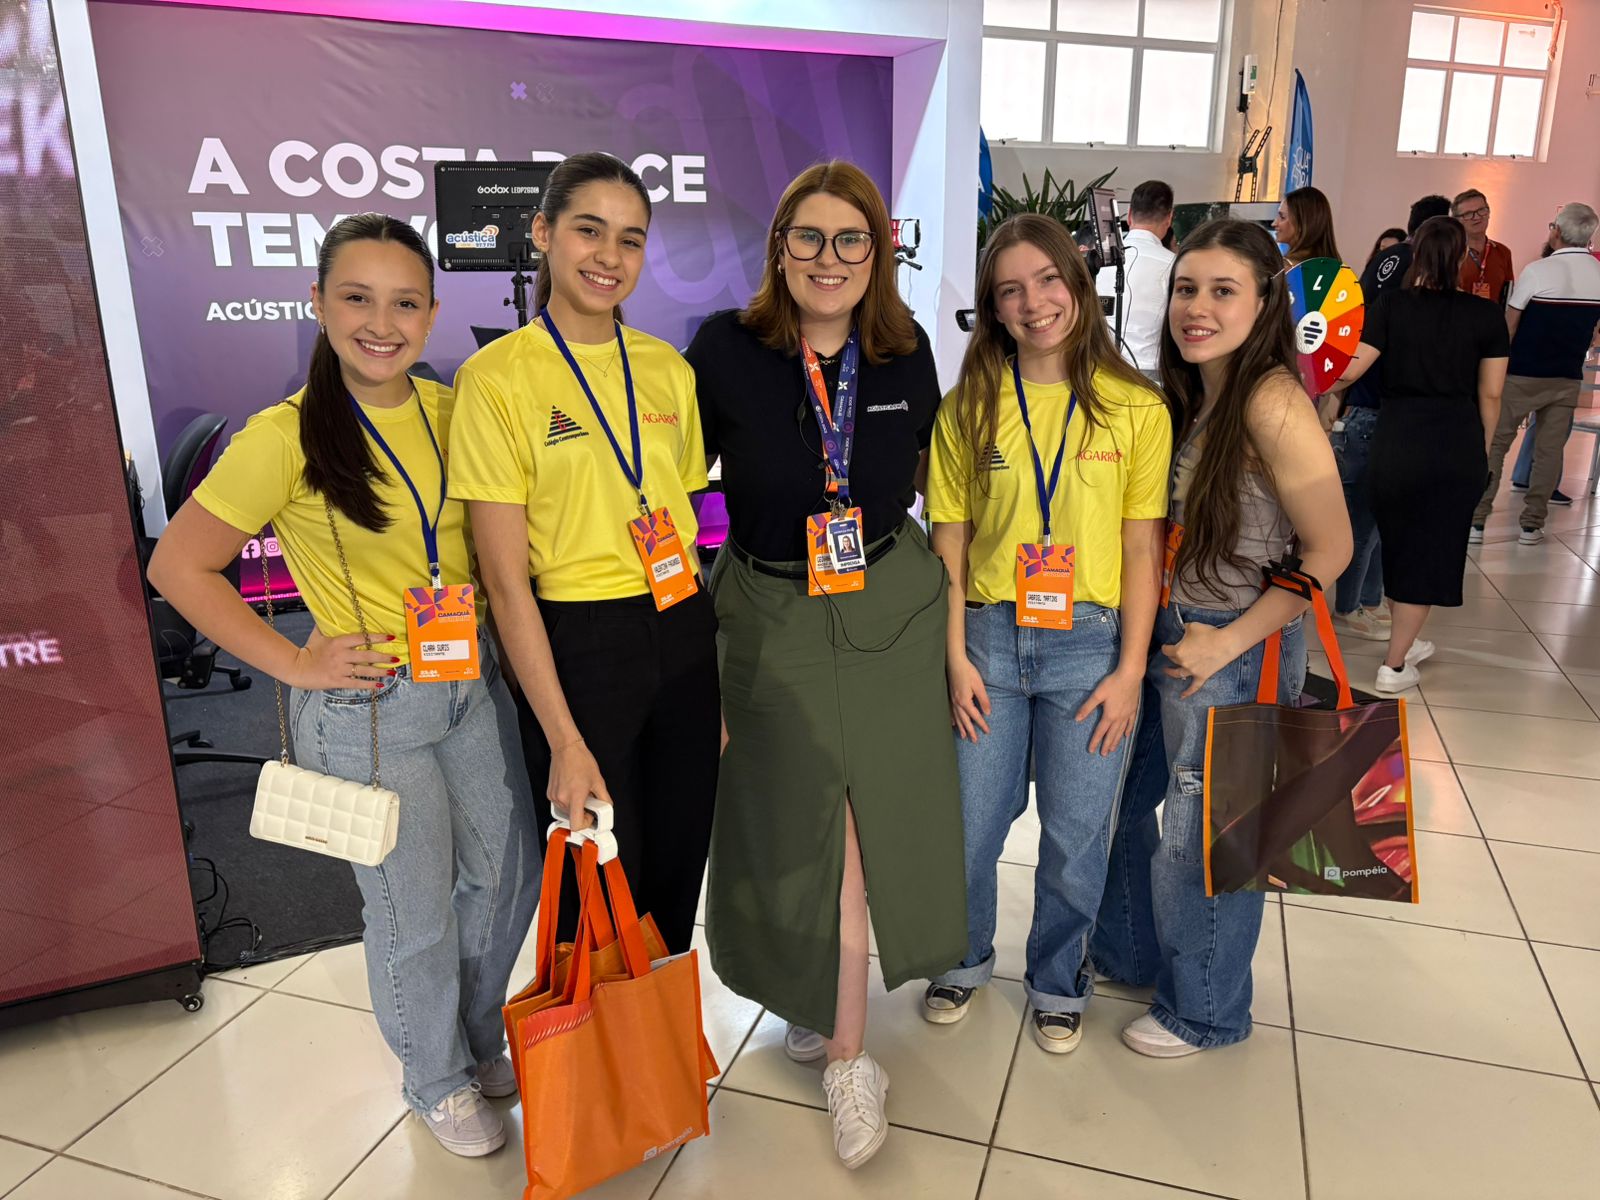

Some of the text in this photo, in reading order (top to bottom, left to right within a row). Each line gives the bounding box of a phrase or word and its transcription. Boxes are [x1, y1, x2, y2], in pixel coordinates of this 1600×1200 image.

[187, 137, 250, 195] A
[268, 140, 497, 200] COS
[477, 184, 509, 194] Godox
[447, 231, 495, 243] acústica
[206, 299, 318, 321] ACÚSTIC
[1338, 325, 1351, 337] 5
[1324, 357, 1334, 373] 4
